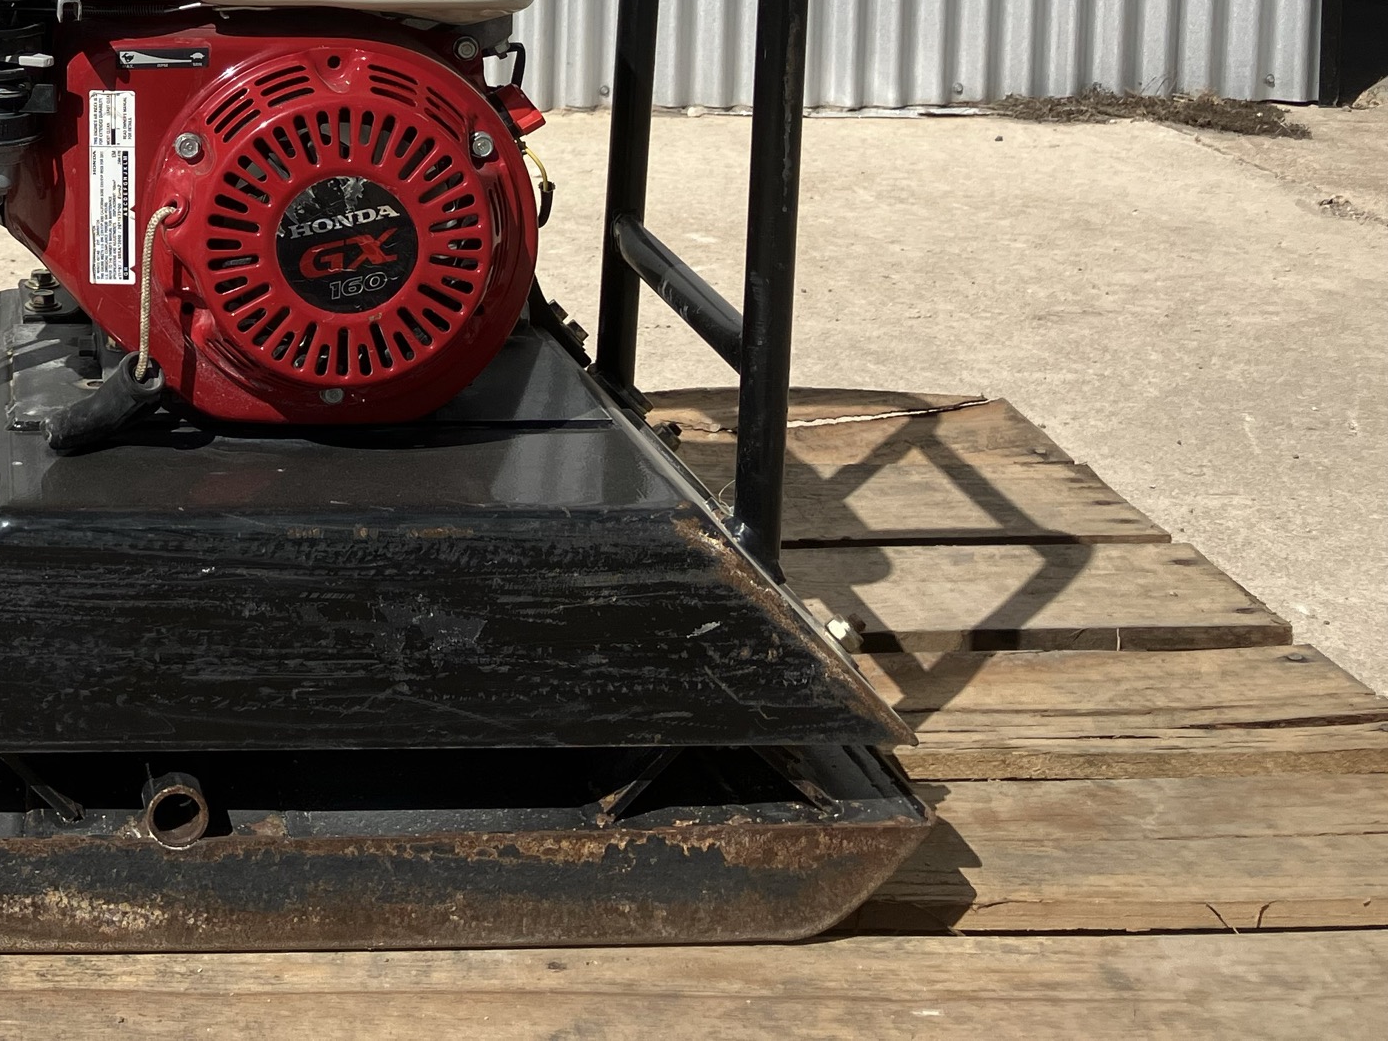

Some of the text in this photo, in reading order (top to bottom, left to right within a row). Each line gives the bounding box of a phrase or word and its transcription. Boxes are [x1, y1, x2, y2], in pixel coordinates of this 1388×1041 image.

[288, 205, 400, 239] HONDA
[299, 228, 398, 279] GX
[329, 271, 388, 300] 160
